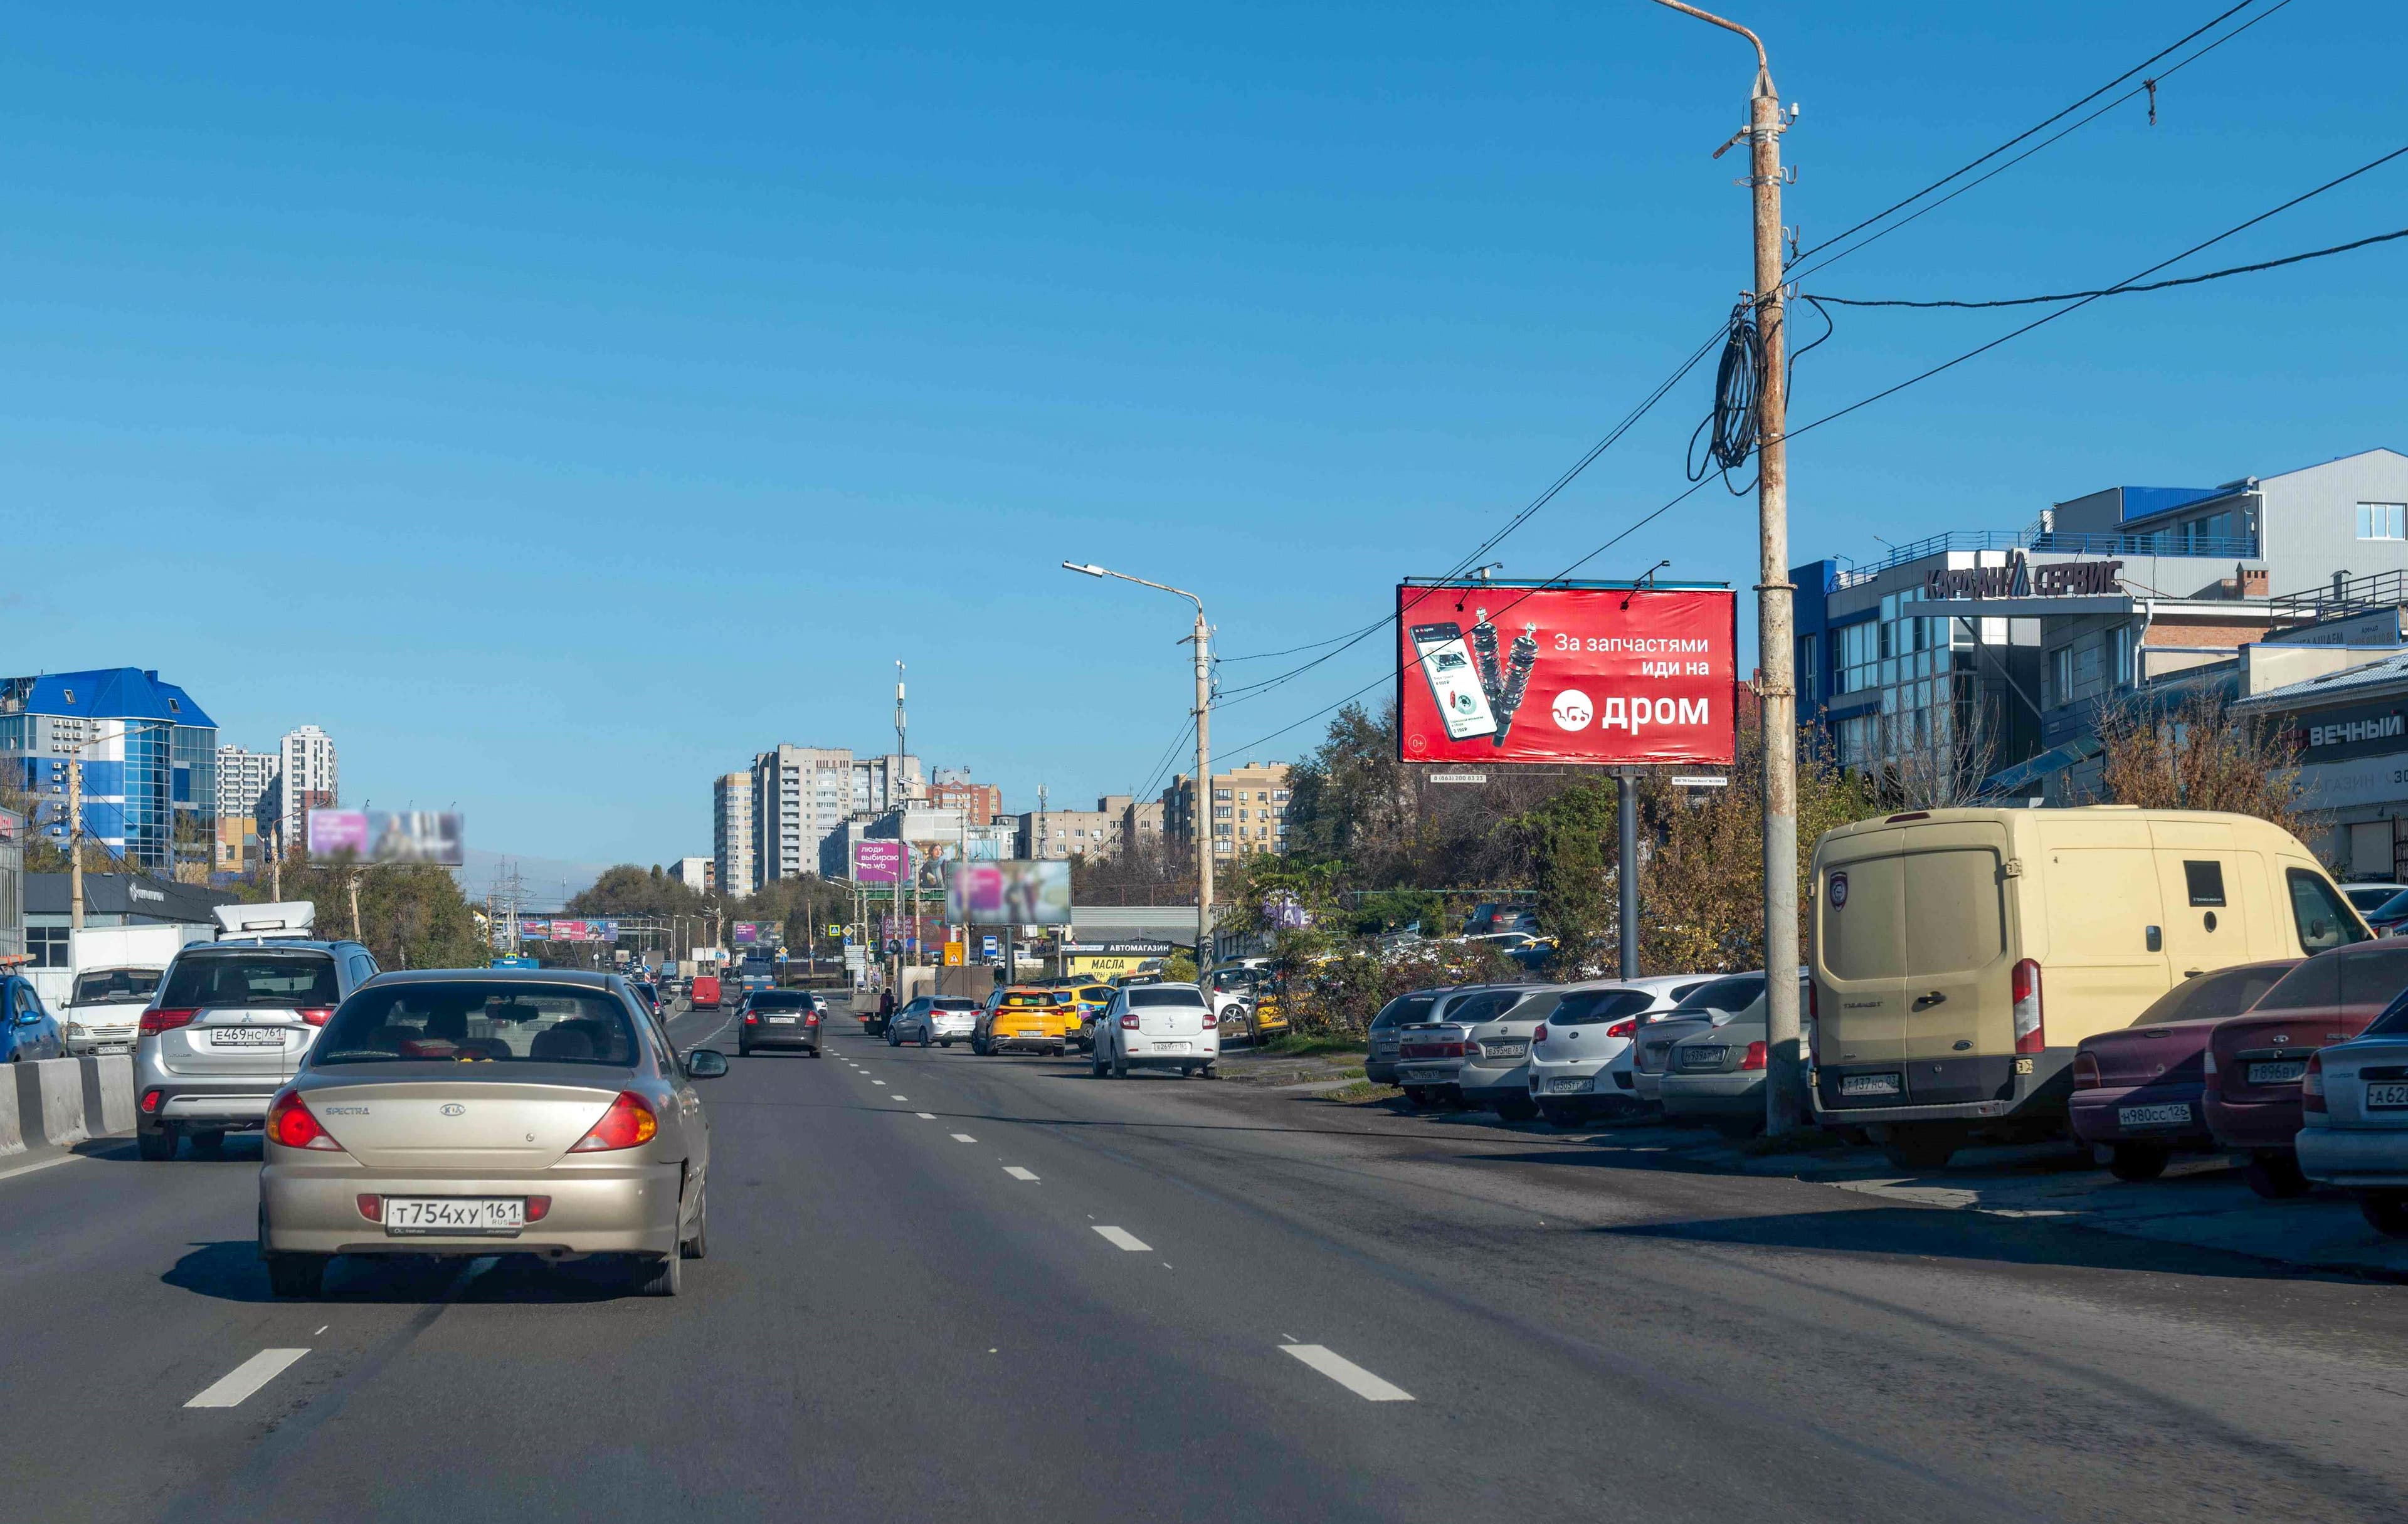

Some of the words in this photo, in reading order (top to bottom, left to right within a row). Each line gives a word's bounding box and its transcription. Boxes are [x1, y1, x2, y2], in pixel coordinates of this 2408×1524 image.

[1924, 567, 2007, 599] КАРДАН
[2034, 560, 2124, 596] СЕРВИС
[1555, 633, 1580, 651] За
[1587, 638, 1708, 653] запчастями
[1642, 661, 1679, 678] иди
[1686, 662, 1709, 675] на
[1602, 697, 1709, 735] дром
[2310, 710, 2405, 747] ВЕЧНЫЙ
[1412, 739, 1423, 747] 0+
[861, 854, 899, 862] выбираю
[1091, 959, 1124, 969] МАСЛА
[216, 1028, 261, 1040] Е469НС
[264, 1028, 282, 1037] 761
[2123, 1109, 2166, 1122] Н980СС
[397, 1203, 478, 1224] Т754ХУ
[486, 1203, 517, 1219] 161
